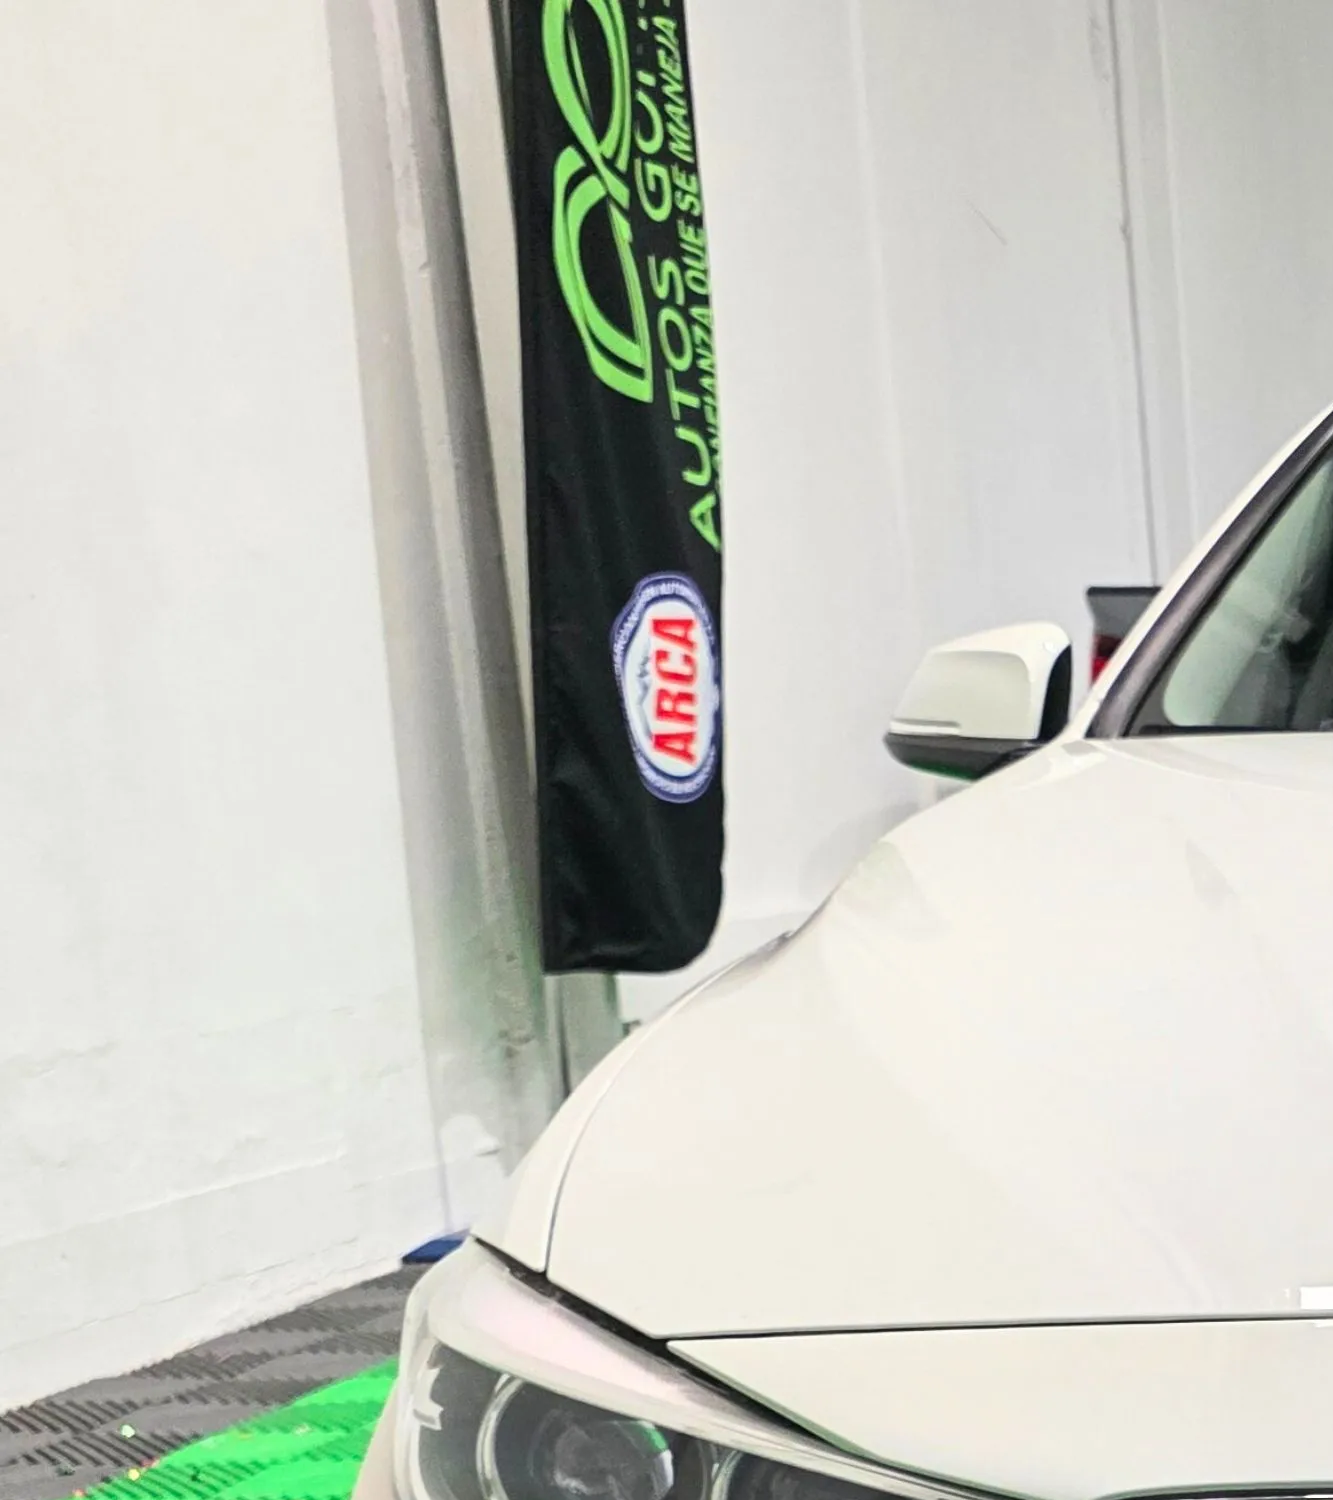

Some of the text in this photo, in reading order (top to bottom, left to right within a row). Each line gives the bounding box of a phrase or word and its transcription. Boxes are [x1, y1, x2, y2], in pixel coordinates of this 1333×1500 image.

[652, 16, 695, 163] MANEJA
[671, 162, 702, 217] SE
[677, 219, 709, 295] QUE
[648, 256, 722, 552] AUTOS
[652, 618, 698, 768] ARCA
